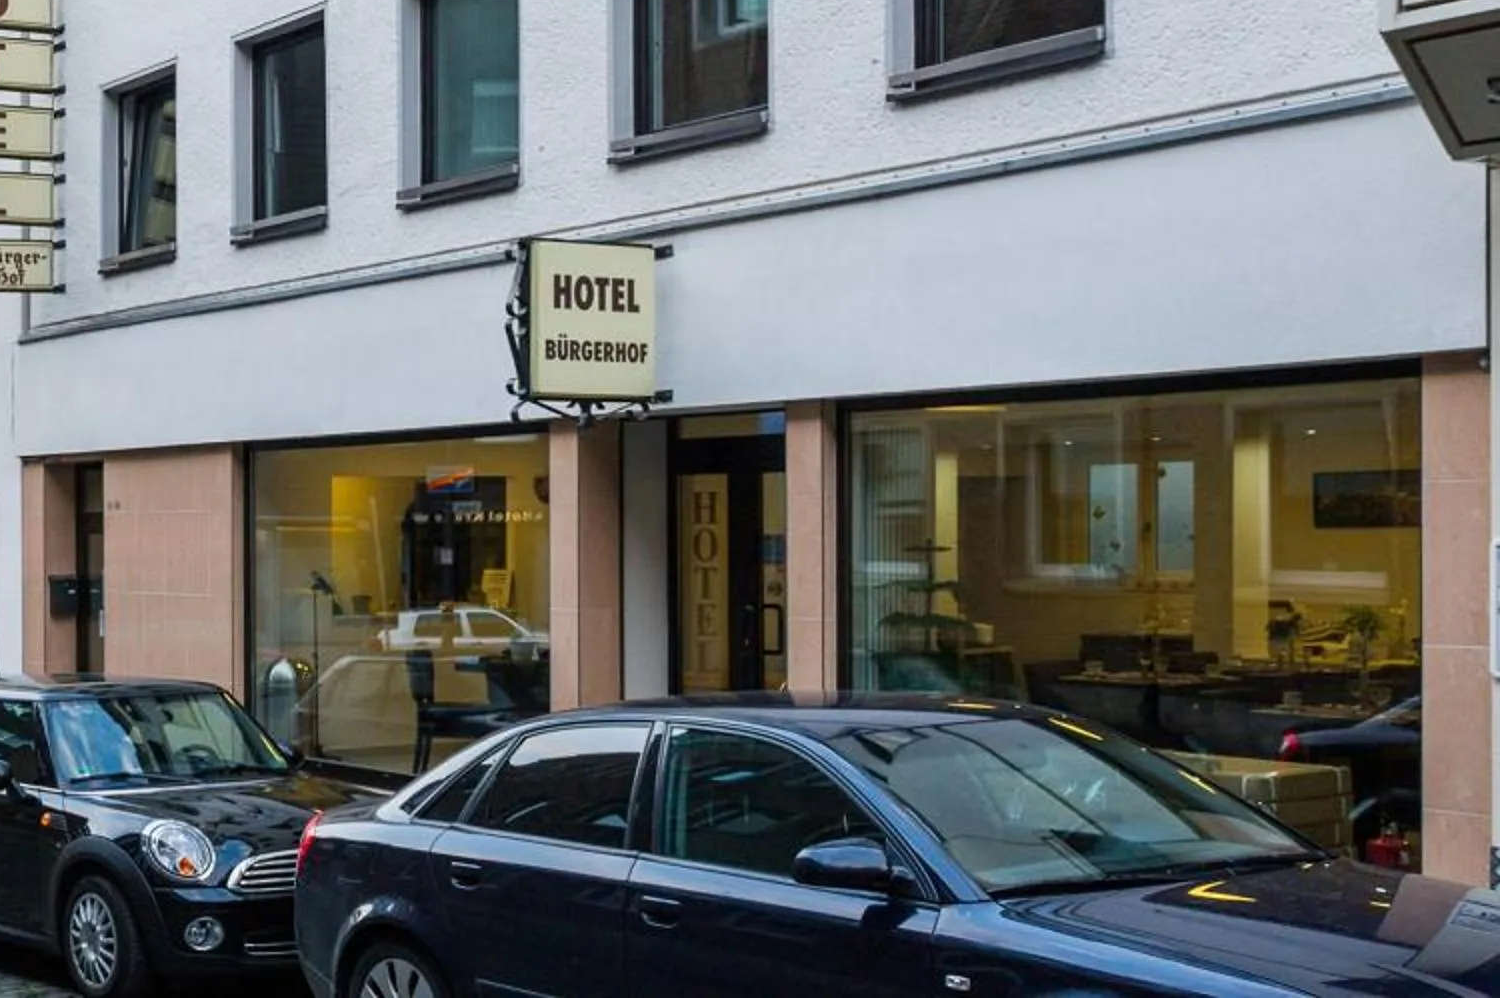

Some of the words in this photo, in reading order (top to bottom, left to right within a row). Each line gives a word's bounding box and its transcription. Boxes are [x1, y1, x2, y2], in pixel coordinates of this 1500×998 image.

[553, 274, 640, 313] HOTEL
[545, 333, 649, 364] BÜRGERHOF
[693, 491, 719, 673] HOTEL
